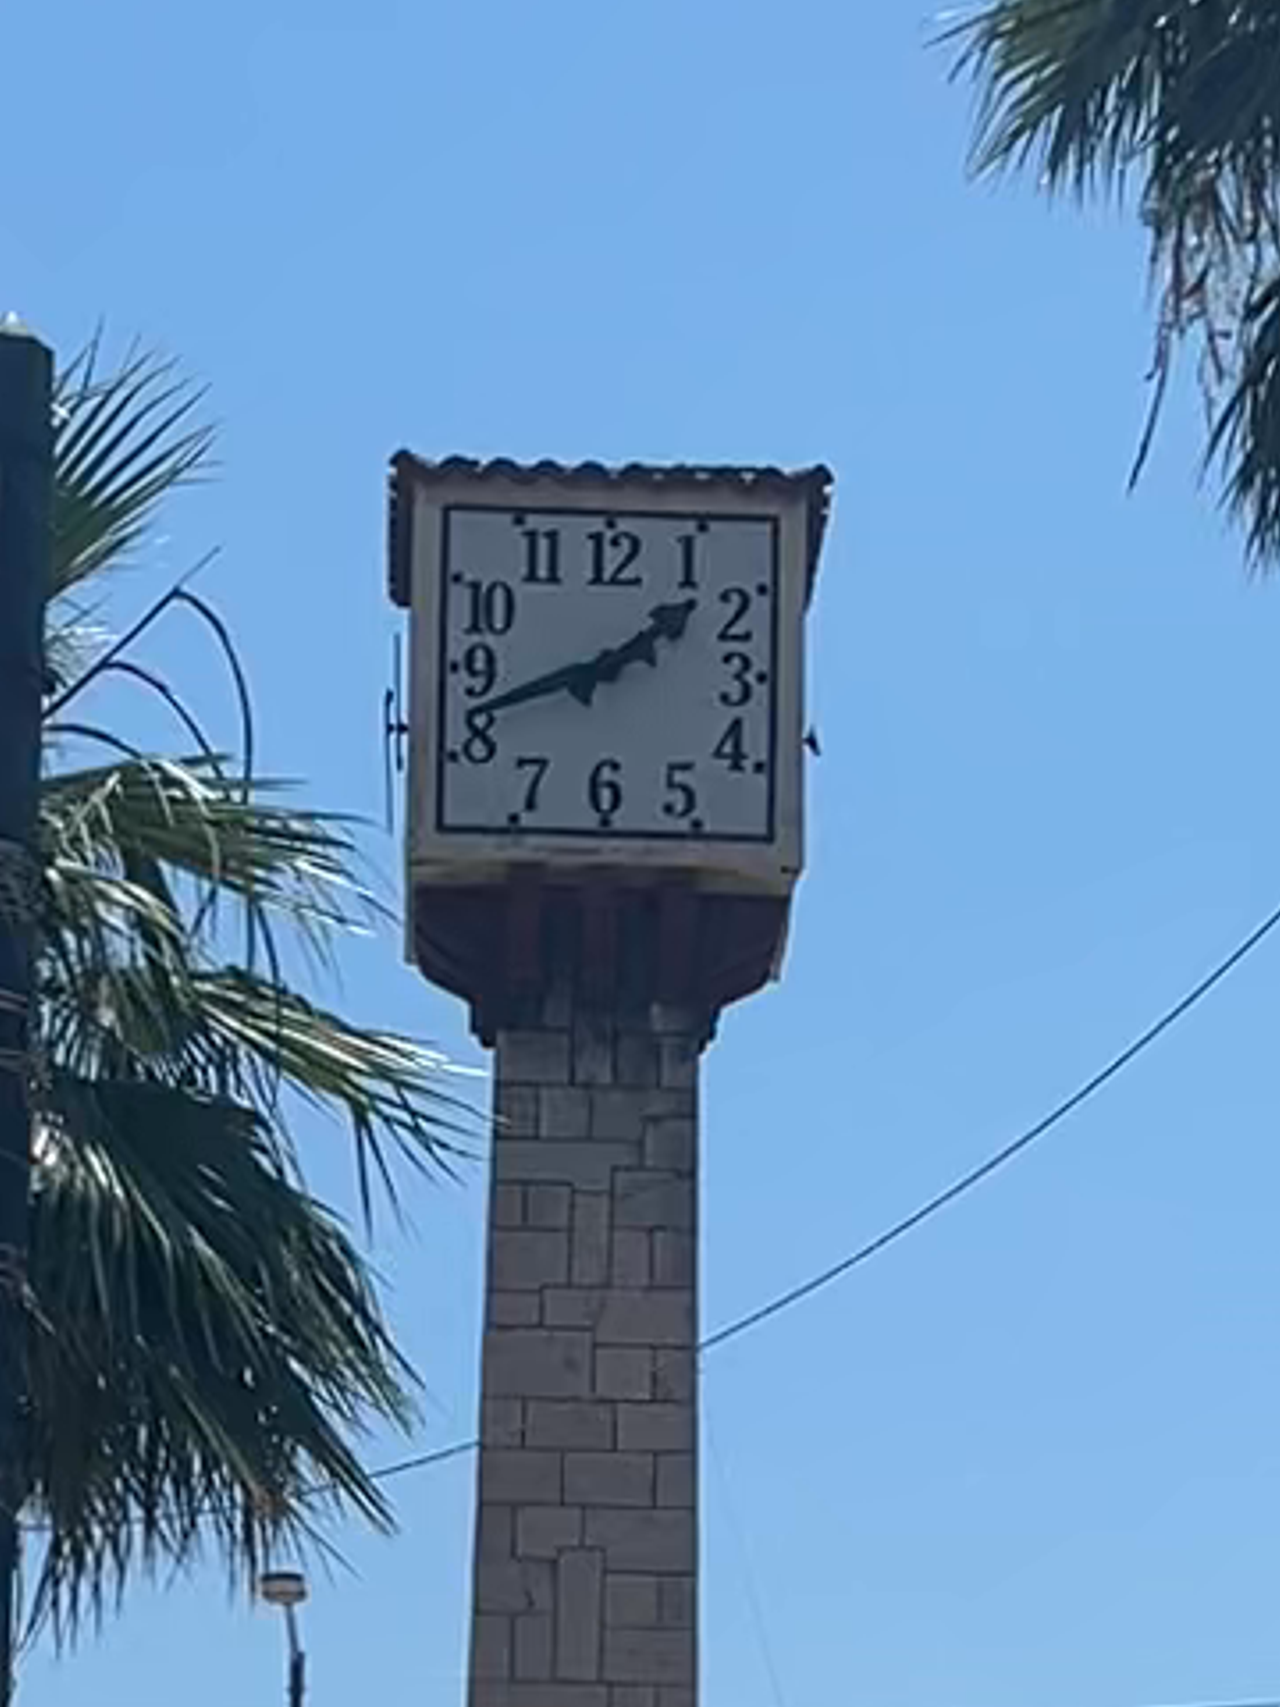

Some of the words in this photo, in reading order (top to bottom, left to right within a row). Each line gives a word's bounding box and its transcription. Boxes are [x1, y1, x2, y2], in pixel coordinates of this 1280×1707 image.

[521, 529, 561, 584] 11
[587, 531, 642, 586] 12
[677, 535, 698, 589] 1
[463, 580, 514, 635] 10
[717, 588, 753, 642] 2
[464, 643, 497, 697] 9
[720, 652, 752, 706] 3
[462, 709, 497, 764] 8
[712, 717, 748, 772] 4
[516, 758, 550, 811] 7
[588, 759, 621, 815] 6
[662, 762, 696, 819] 5
